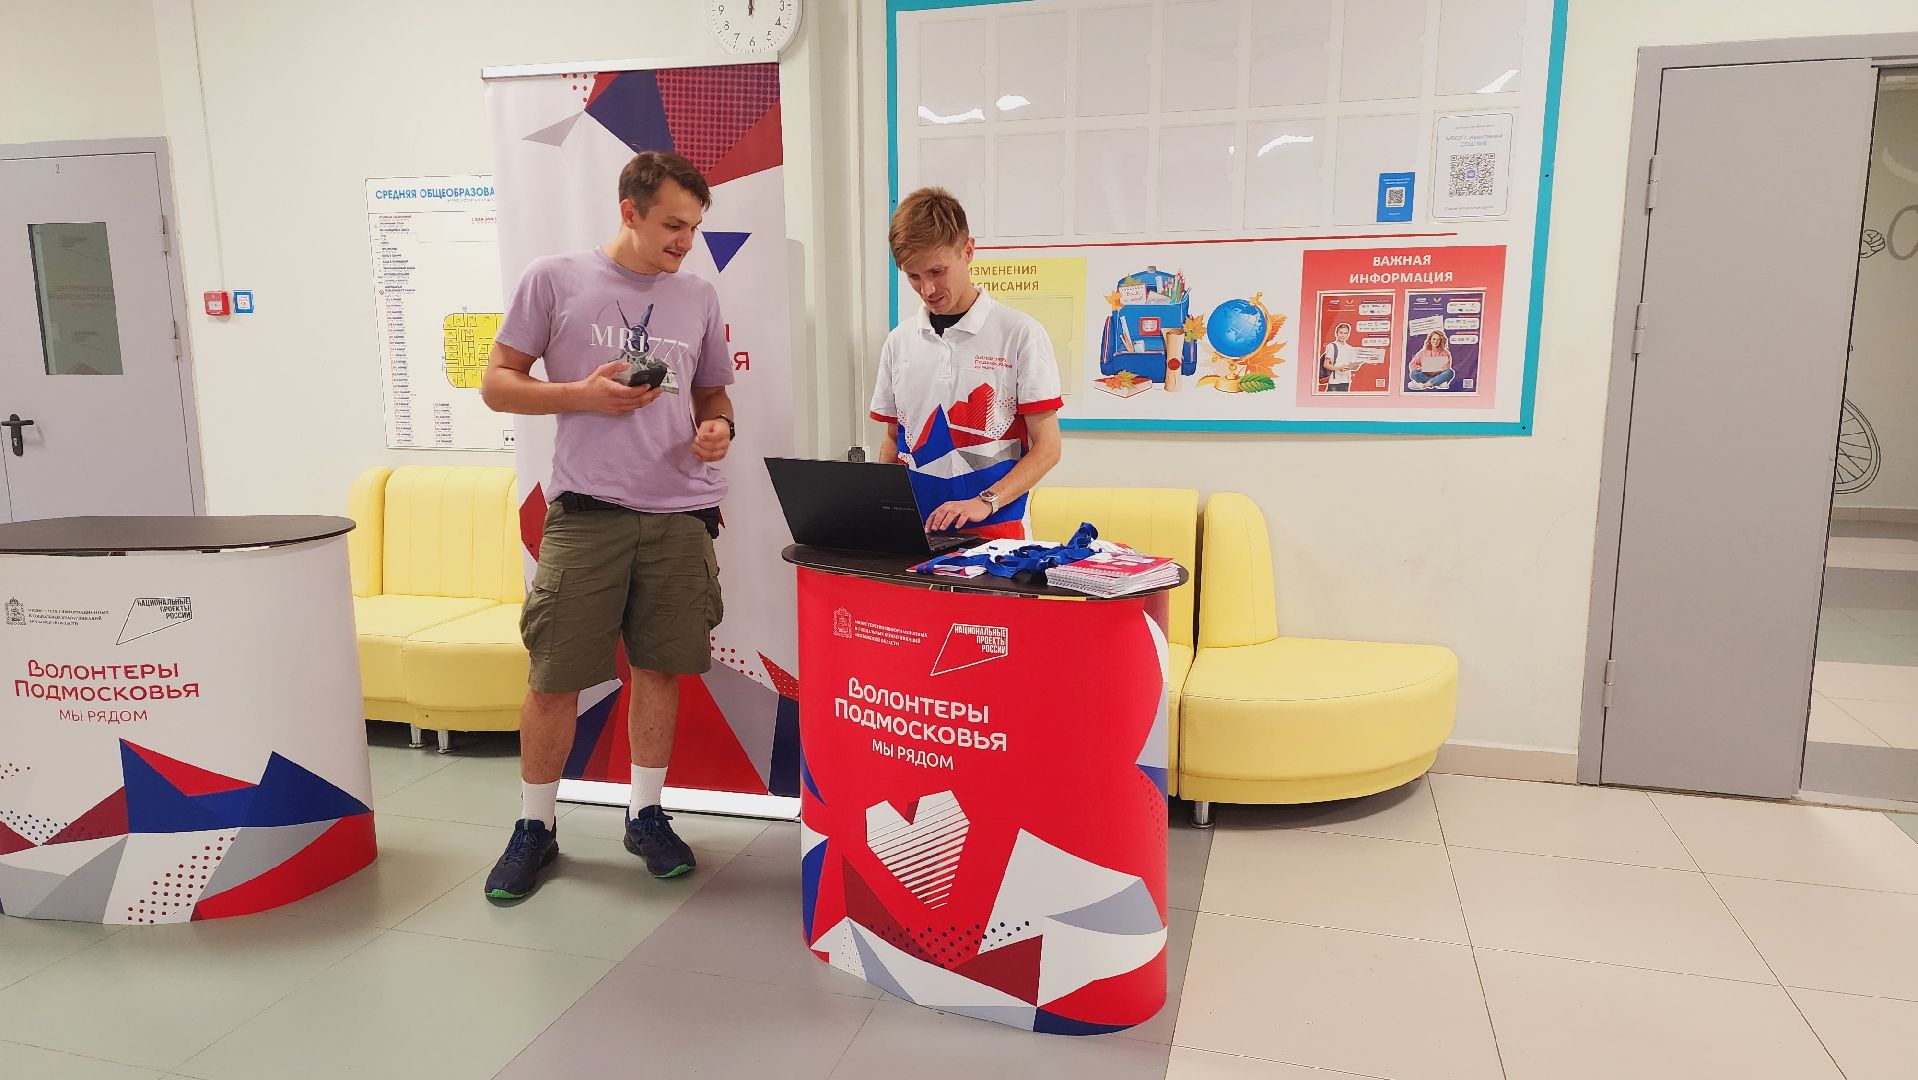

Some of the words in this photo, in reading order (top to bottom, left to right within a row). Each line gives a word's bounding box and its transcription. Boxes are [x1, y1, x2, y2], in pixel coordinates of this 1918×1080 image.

[718, 4, 725, 15] 9
[723, 20, 730, 30] 8
[774, 16, 781, 26] 4
[749, 36, 756, 47] 6
[766, 30, 772, 41] 5
[375, 189, 417, 200] СРЕДНЯЯ
[419, 187, 495, 200] ОБЩЕОБРАЗОВА
[1372, 254, 1432, 267] ВАЖНАЯ
[1349, 271, 1454, 285] ИНФОРМАЦИЯ
[137, 598, 190, 607] НАЦИОНАЛЬНЫЕ
[160, 605, 190, 613] ПРОЕКТЫ
[166, 612, 191, 620] РОССИИ
[954, 625, 1006, 638] НАЦИОНАЛЬНЫЕ
[976, 635, 1006, 646] ПРОЕКТЫ
[981, 644, 1006, 654] РОССИИ
[27, 659, 179, 680] ВОЛОНТЕРЫ
[15, 680, 200, 702] ПОДМОСКОВЬЯ
[848, 676, 989, 724] ВОЛОНТЕРЫ
[88, 709, 148, 725] РЯДОМ
[834, 697, 1007, 752] ПОДМОСКОВЬЯ
[897, 745, 954, 771] РЯДОМ
